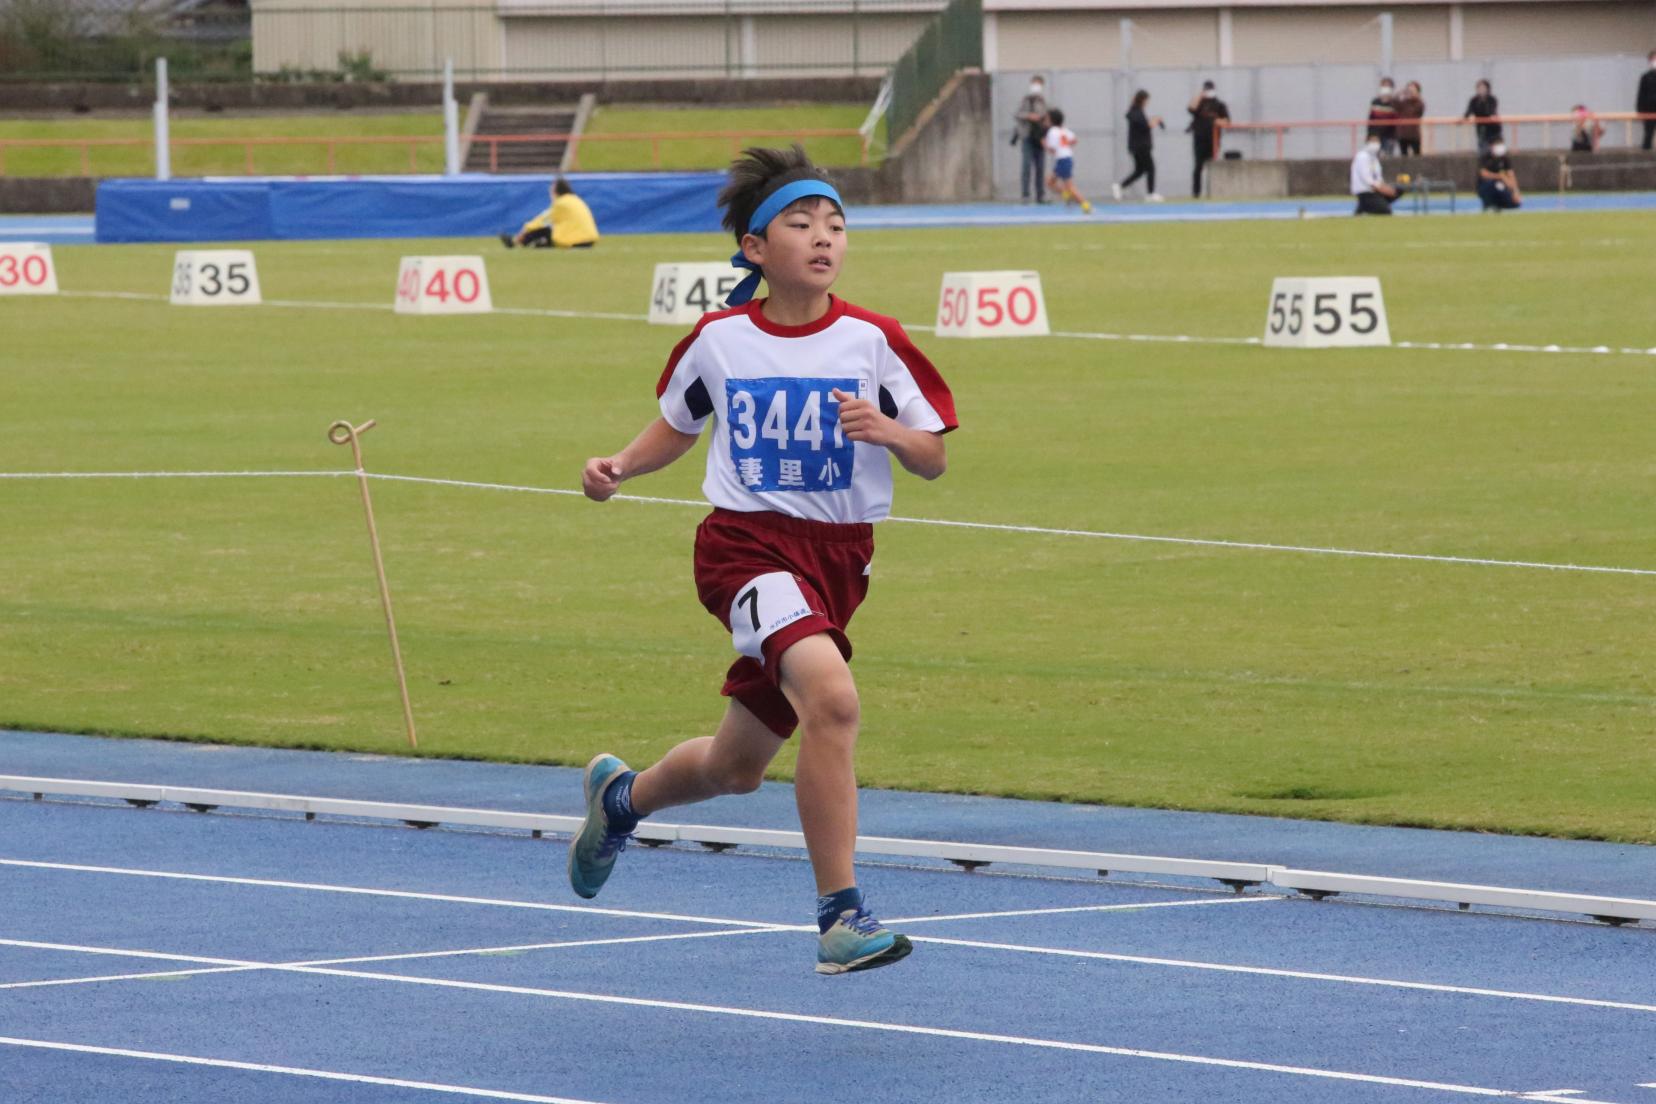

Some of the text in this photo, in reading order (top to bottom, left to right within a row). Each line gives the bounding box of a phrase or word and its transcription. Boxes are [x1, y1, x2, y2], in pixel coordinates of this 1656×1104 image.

[0, 254, 48, 287] 30
[200, 263, 250, 296] 35
[425, 268, 480, 304] 40
[654, 277, 677, 313] 45
[941, 287, 969, 327] 50
[976, 286, 1037, 328] 50
[1270, 293, 1303, 335] 55
[1313, 292, 1378, 334] 55
[737, 585, 761, 633] 7
